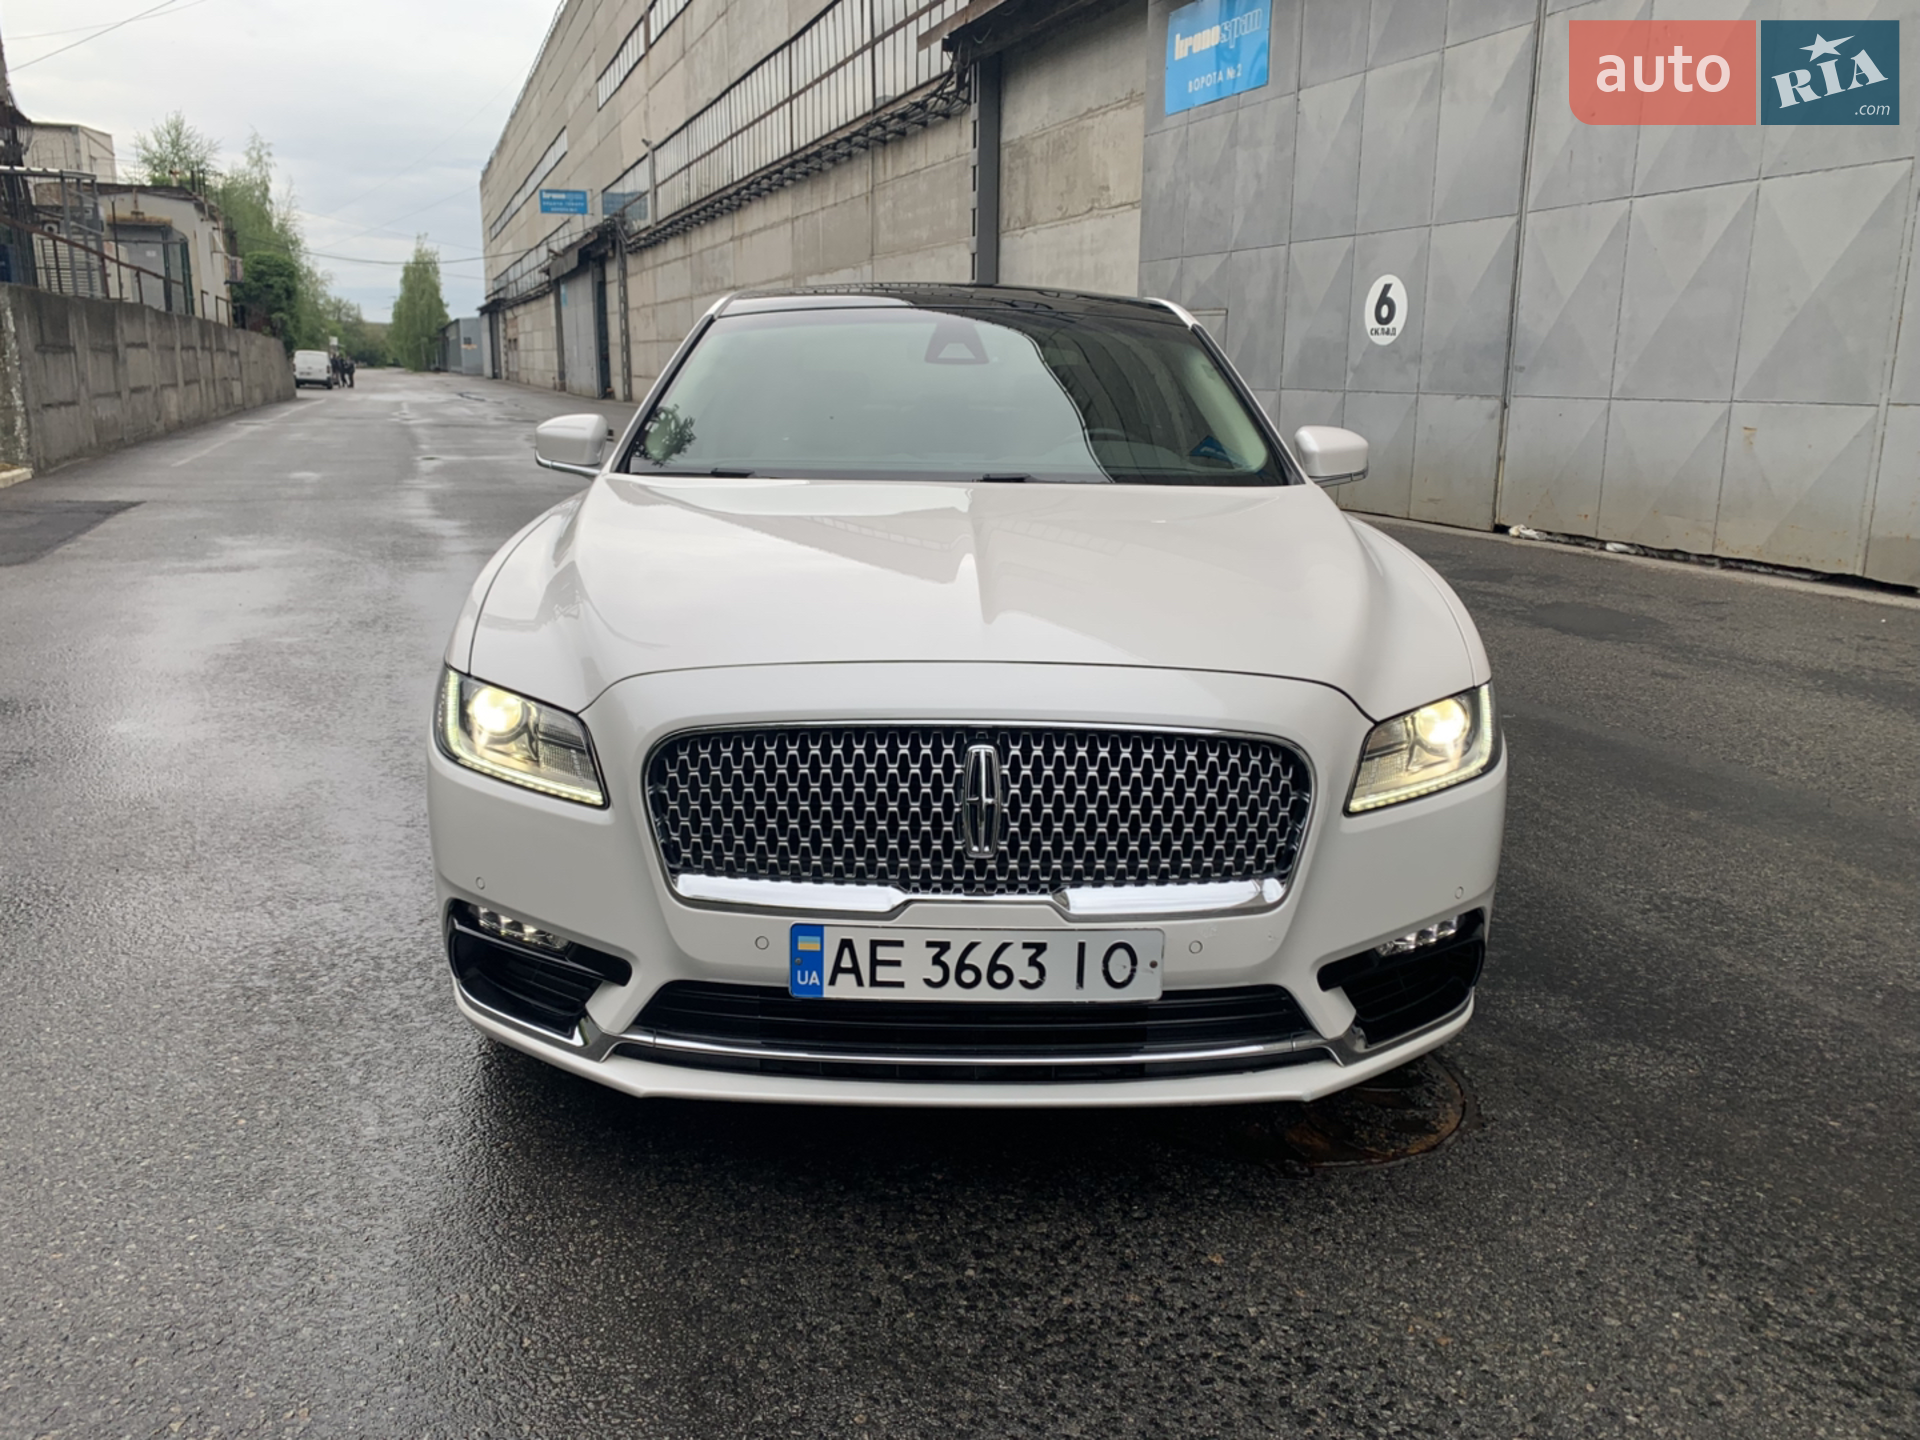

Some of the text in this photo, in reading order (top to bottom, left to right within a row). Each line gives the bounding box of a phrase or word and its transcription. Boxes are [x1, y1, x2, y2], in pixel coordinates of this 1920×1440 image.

[1374, 283, 1397, 326] 6
[796, 970, 821, 986] UA
[827, 938, 906, 988] AE
[922, 940, 1049, 990] 3663
